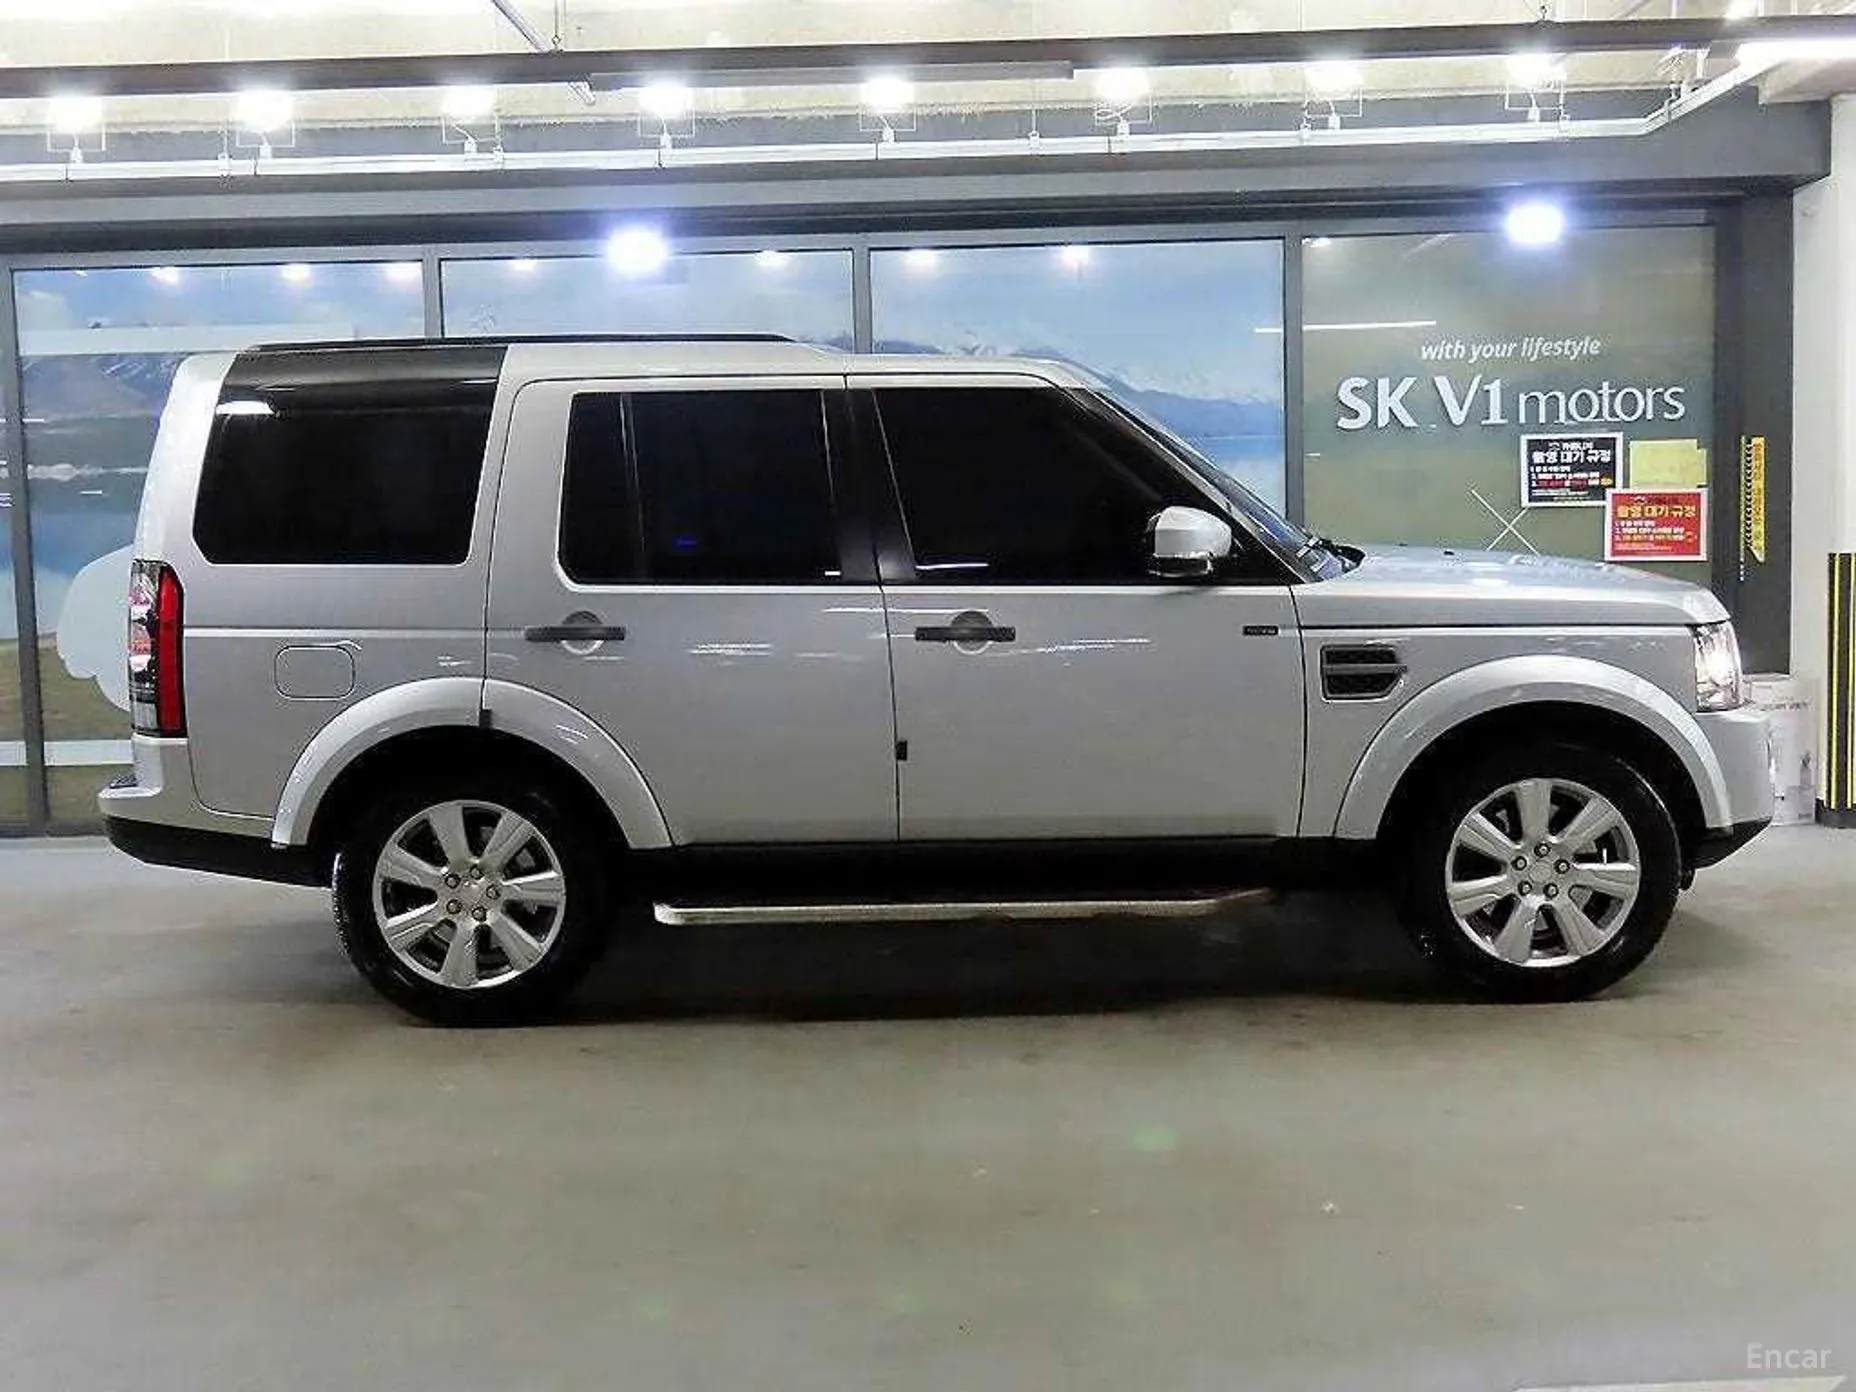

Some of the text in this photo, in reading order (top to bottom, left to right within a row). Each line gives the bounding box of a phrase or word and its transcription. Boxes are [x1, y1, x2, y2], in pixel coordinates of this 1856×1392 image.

[1421, 336, 1602, 364] with your lifestyle
[1337, 374, 1686, 430] SK V1 motors
[1560, 449, 1584, 463] 대기
[1643, 505, 1668, 518] 대기
